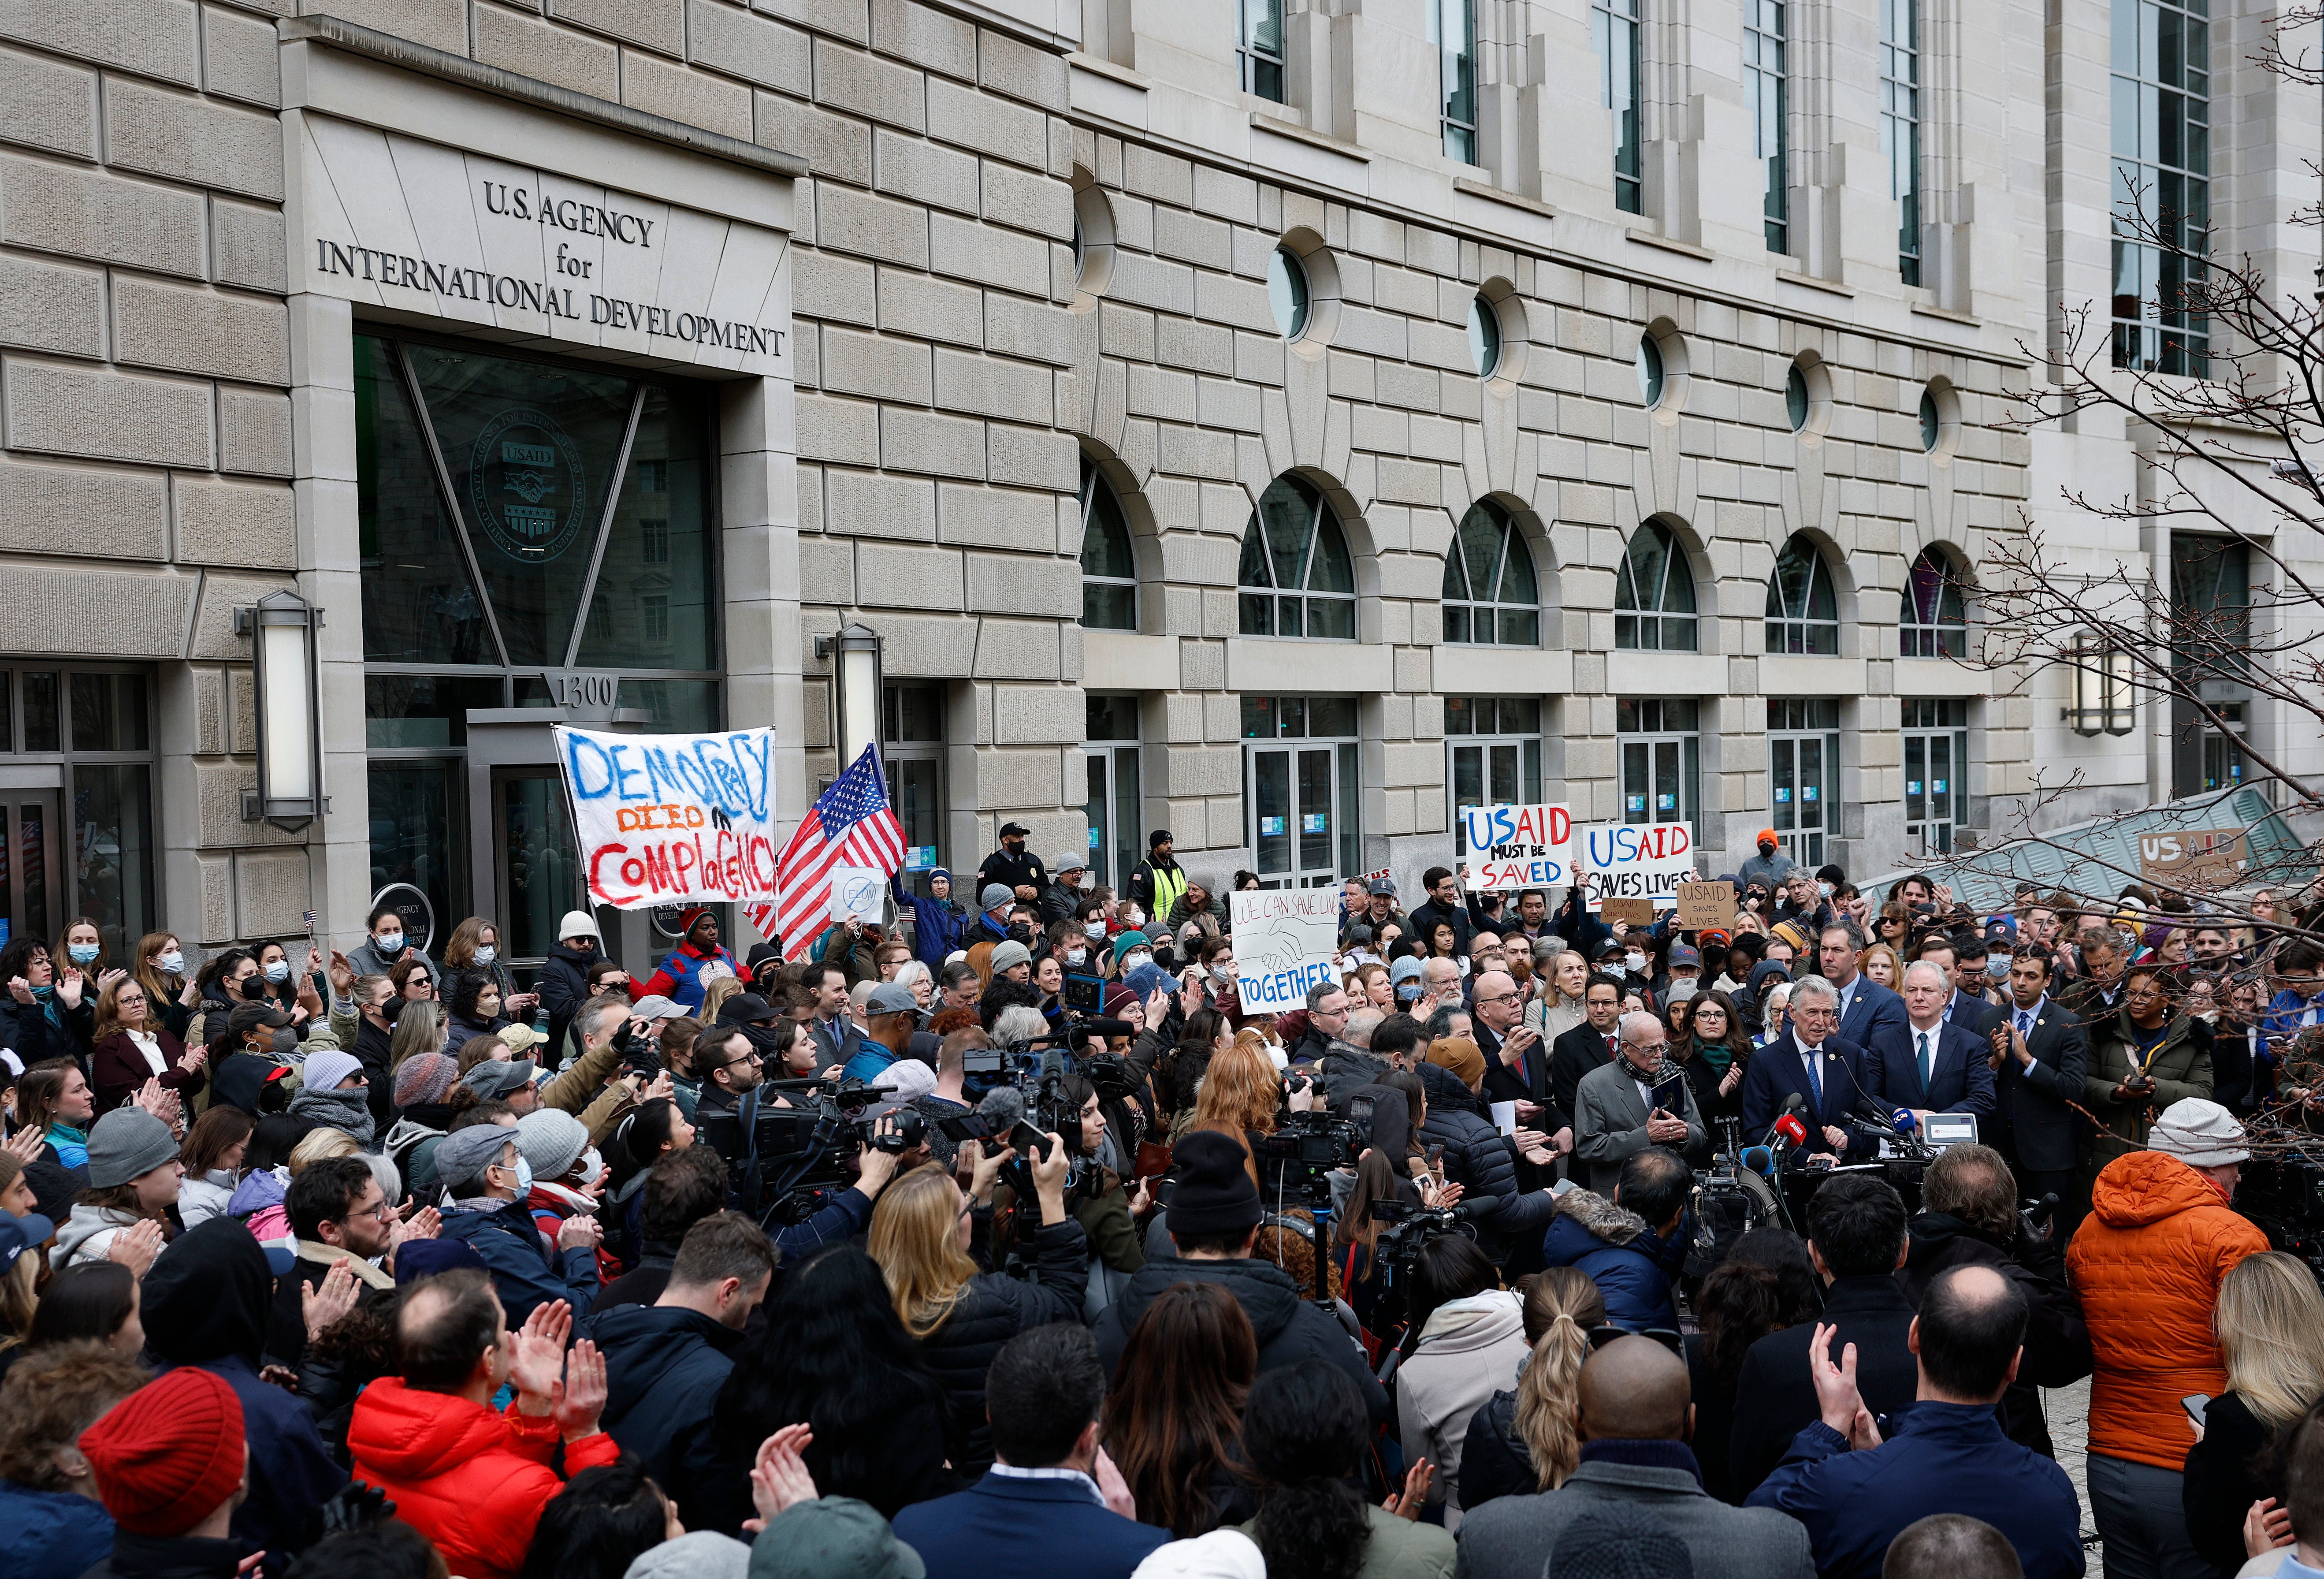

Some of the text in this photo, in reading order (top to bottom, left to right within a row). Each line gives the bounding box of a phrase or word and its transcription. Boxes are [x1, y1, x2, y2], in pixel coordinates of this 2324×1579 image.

[483, 181, 654, 248] U.S. AGENCY
[556, 242, 592, 279] for
[317, 238, 785, 357] INTERNATIONAL DEVELOPMENT
[506, 447, 552, 463] USAID
[559, 675, 612, 708] 1300
[1468, 807, 1571, 851] USAID
[1490, 844, 1546, 861] MUST BE
[1590, 826, 1689, 868] USAID
[2142, 832, 2236, 862] USAID
[1481, 861, 1561, 888] SAVED
[1587, 871, 1641, 902] SAVES
[849, 888, 874, 901] ELON
[1613, 899, 1637, 908] USAID
[1683, 886, 1726, 901] USAID
[1232, 894, 1339, 925] WE CAN SAVE LIVES
[1604, 909, 1623, 917] Saves
[1689, 917, 1720, 926] LIVES
[1238, 962, 1331, 1006] TOGETHER
